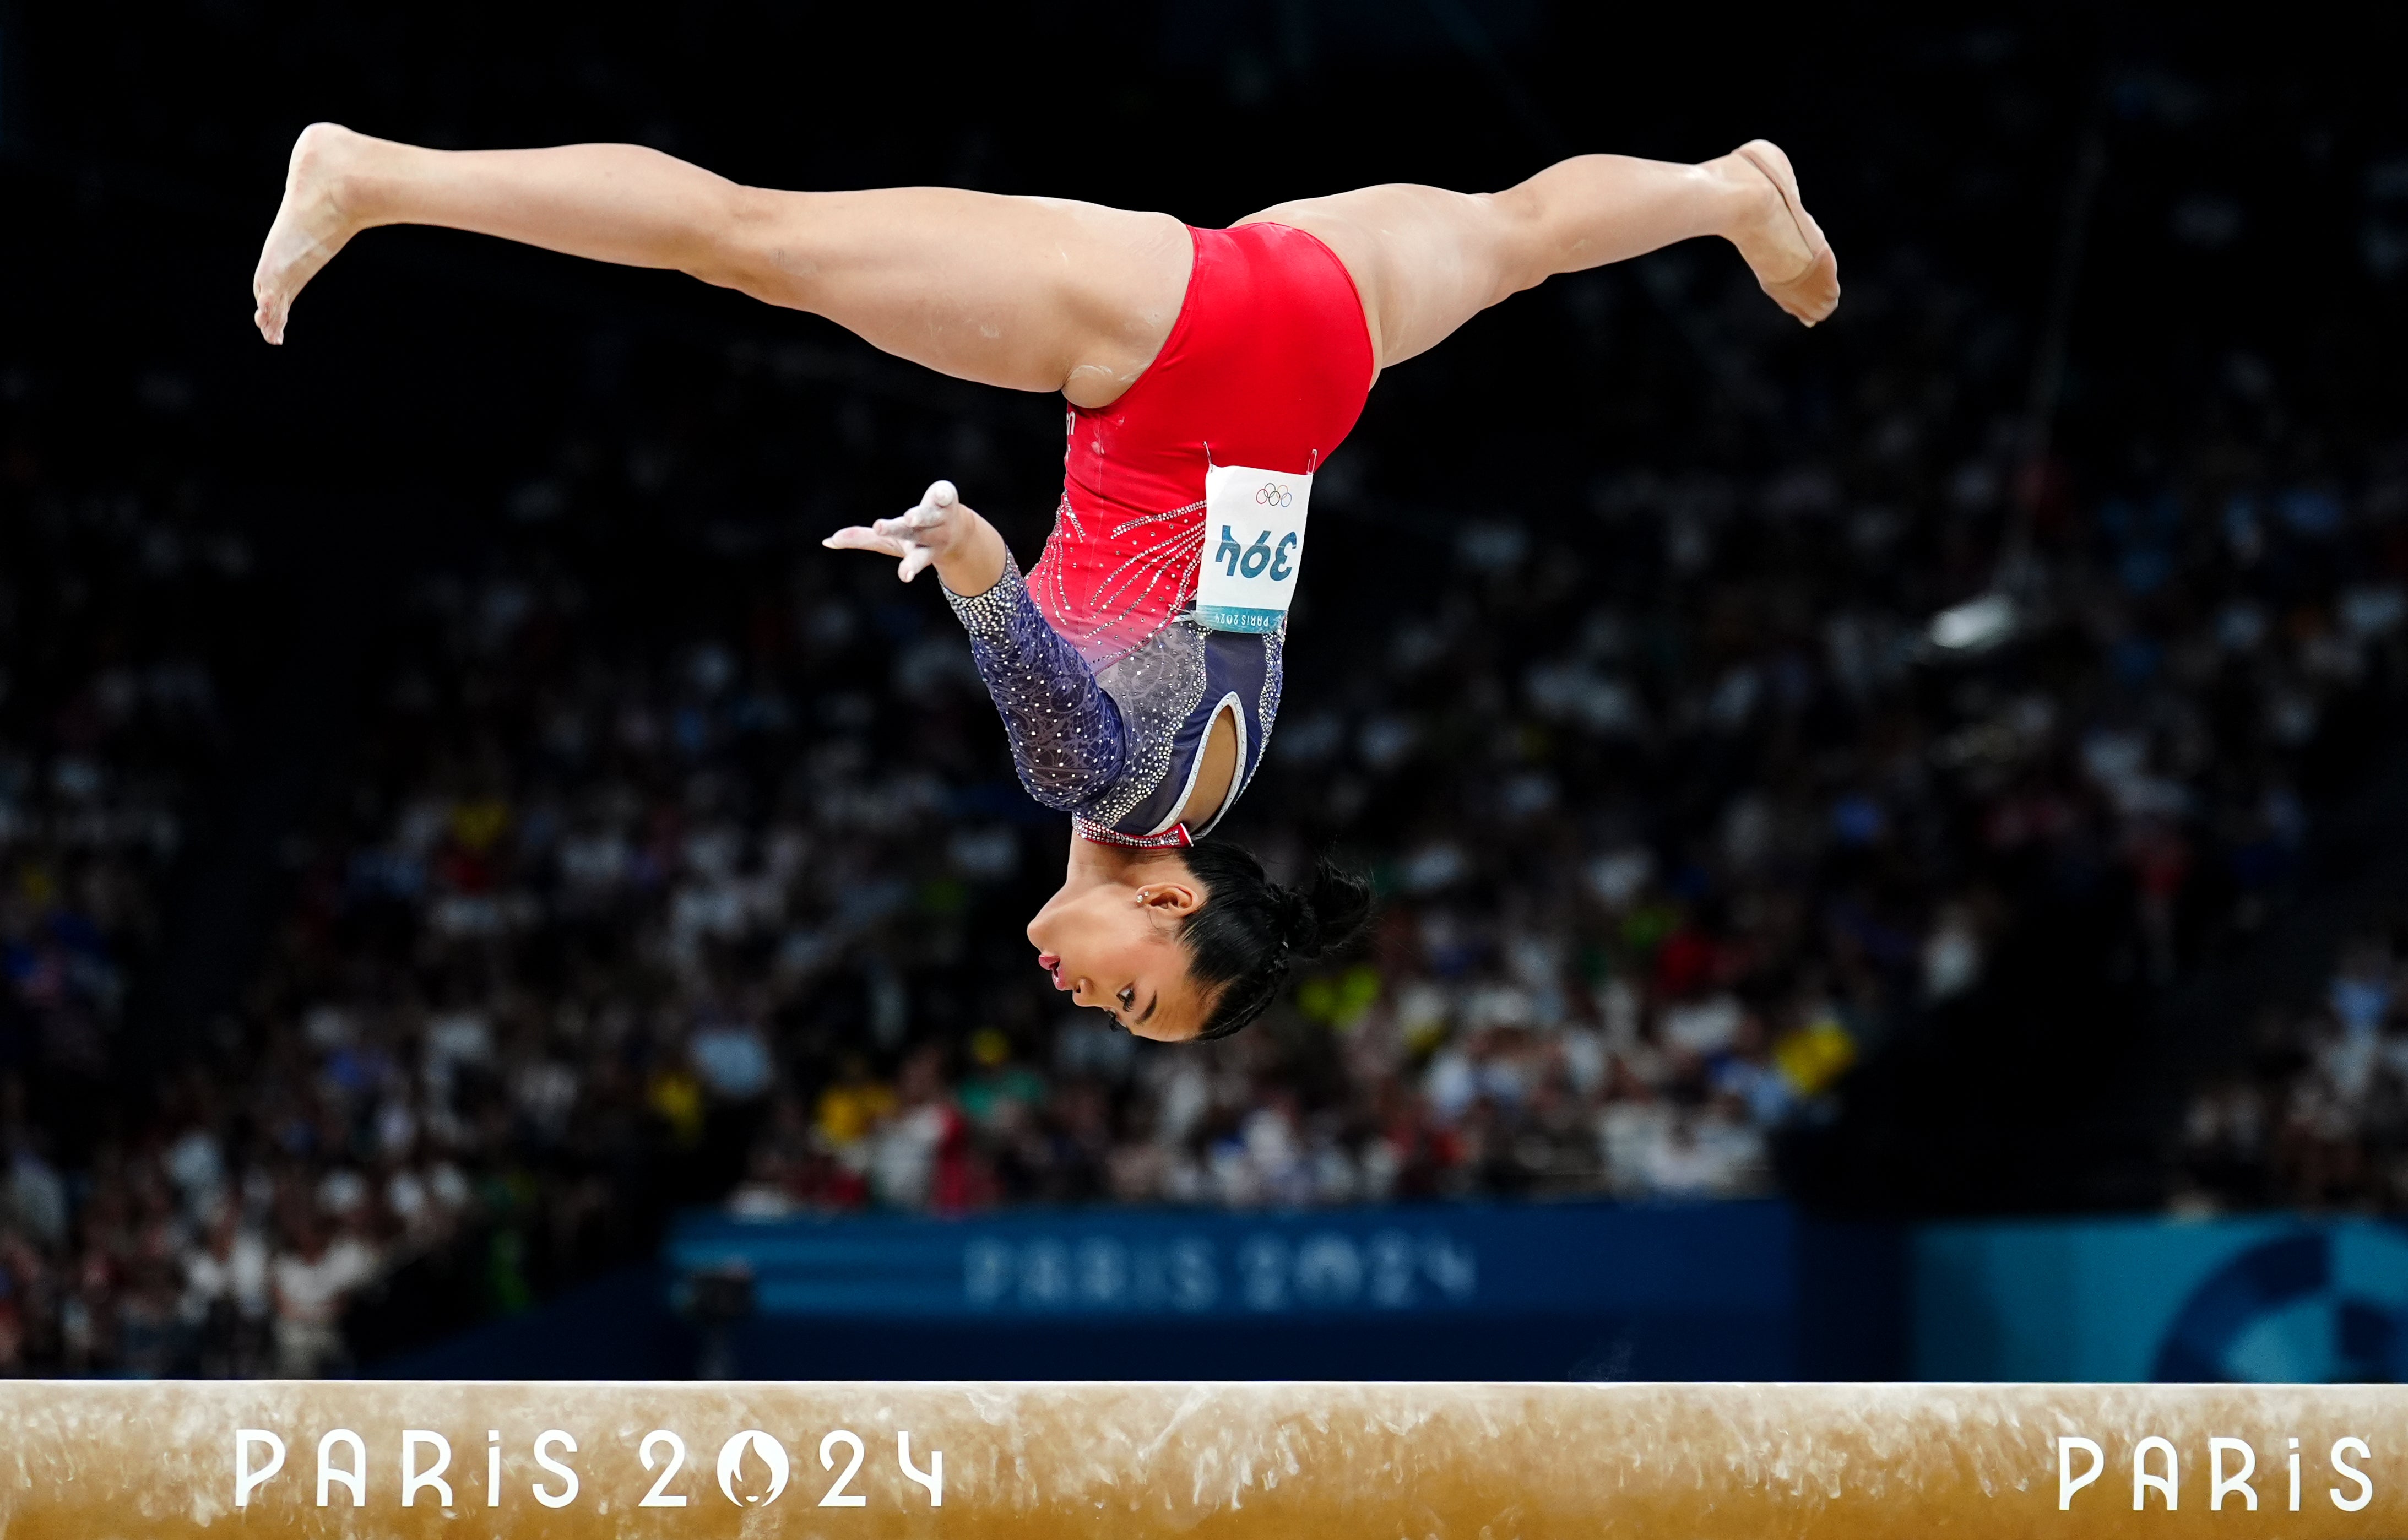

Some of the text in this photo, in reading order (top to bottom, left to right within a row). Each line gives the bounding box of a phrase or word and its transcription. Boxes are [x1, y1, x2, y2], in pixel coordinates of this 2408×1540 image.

[1215, 525, 1297, 581] 394
[1214, 613, 1239, 625] 2024
[1236, 1233, 1476, 1311] 2024
[639, 1429, 942, 1508] 2024
